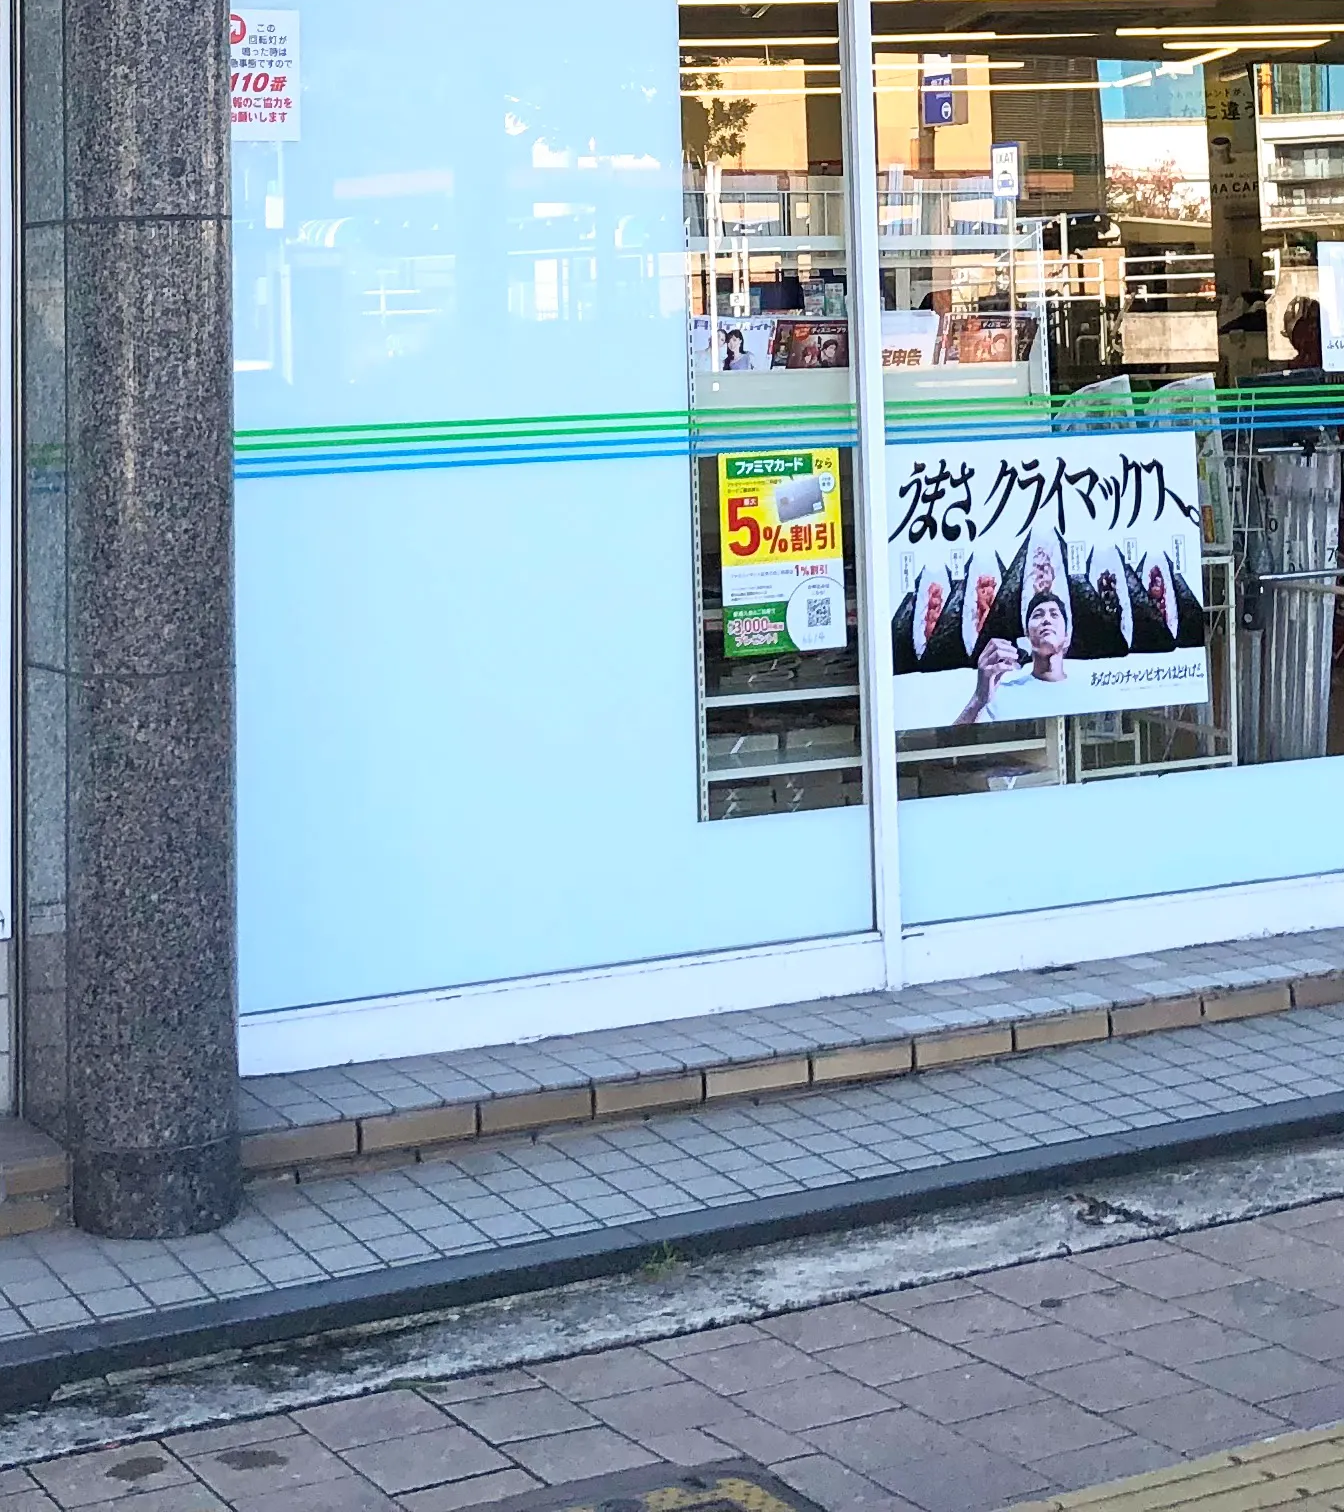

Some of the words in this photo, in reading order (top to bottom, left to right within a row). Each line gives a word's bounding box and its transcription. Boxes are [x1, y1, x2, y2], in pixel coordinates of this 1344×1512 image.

[256, 23, 276, 33] この
[735, 458, 804, 475] ファミマカード
[814, 457, 833, 470] なら
